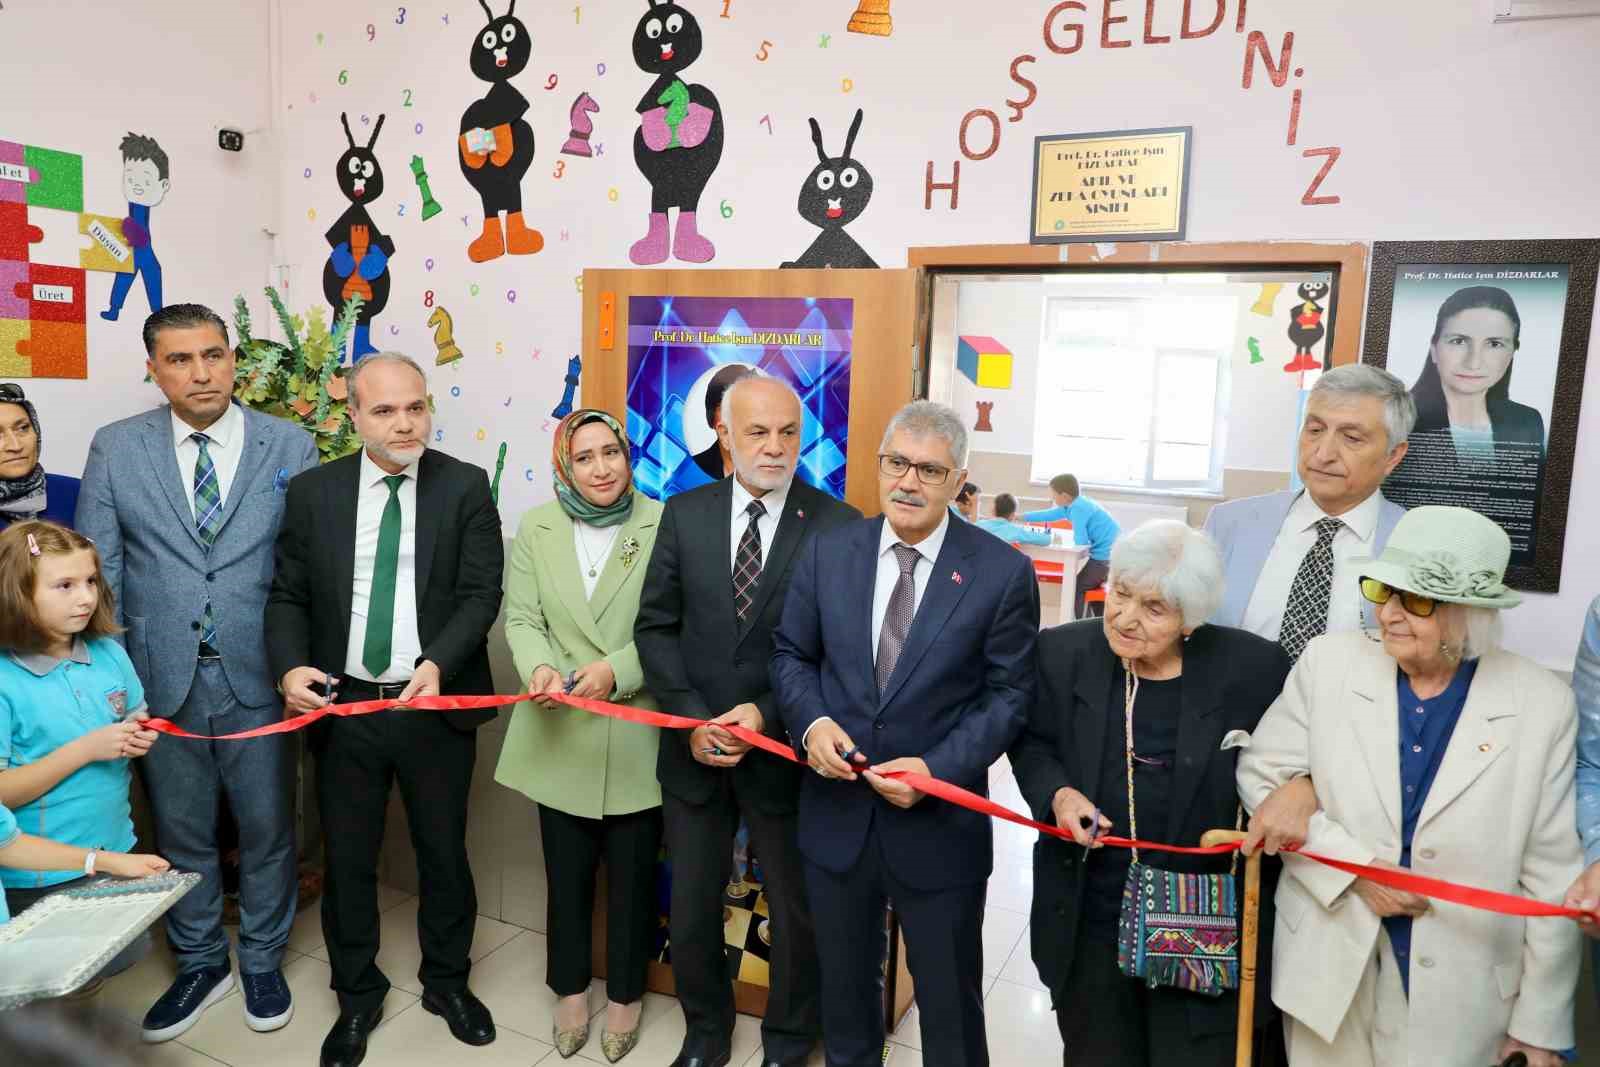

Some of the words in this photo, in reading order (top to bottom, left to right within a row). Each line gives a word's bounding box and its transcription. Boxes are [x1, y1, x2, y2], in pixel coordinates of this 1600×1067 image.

[395, 7, 407, 24] 3
[367, 24, 376, 42] 9
[756, 41, 773, 61] 5
[337, 69, 348, 85] 6
[402, 89, 412, 107] 2
[553, 160, 566, 179] 3
[720, 200, 733, 219] 6
[424, 290, 434, 307] 8
